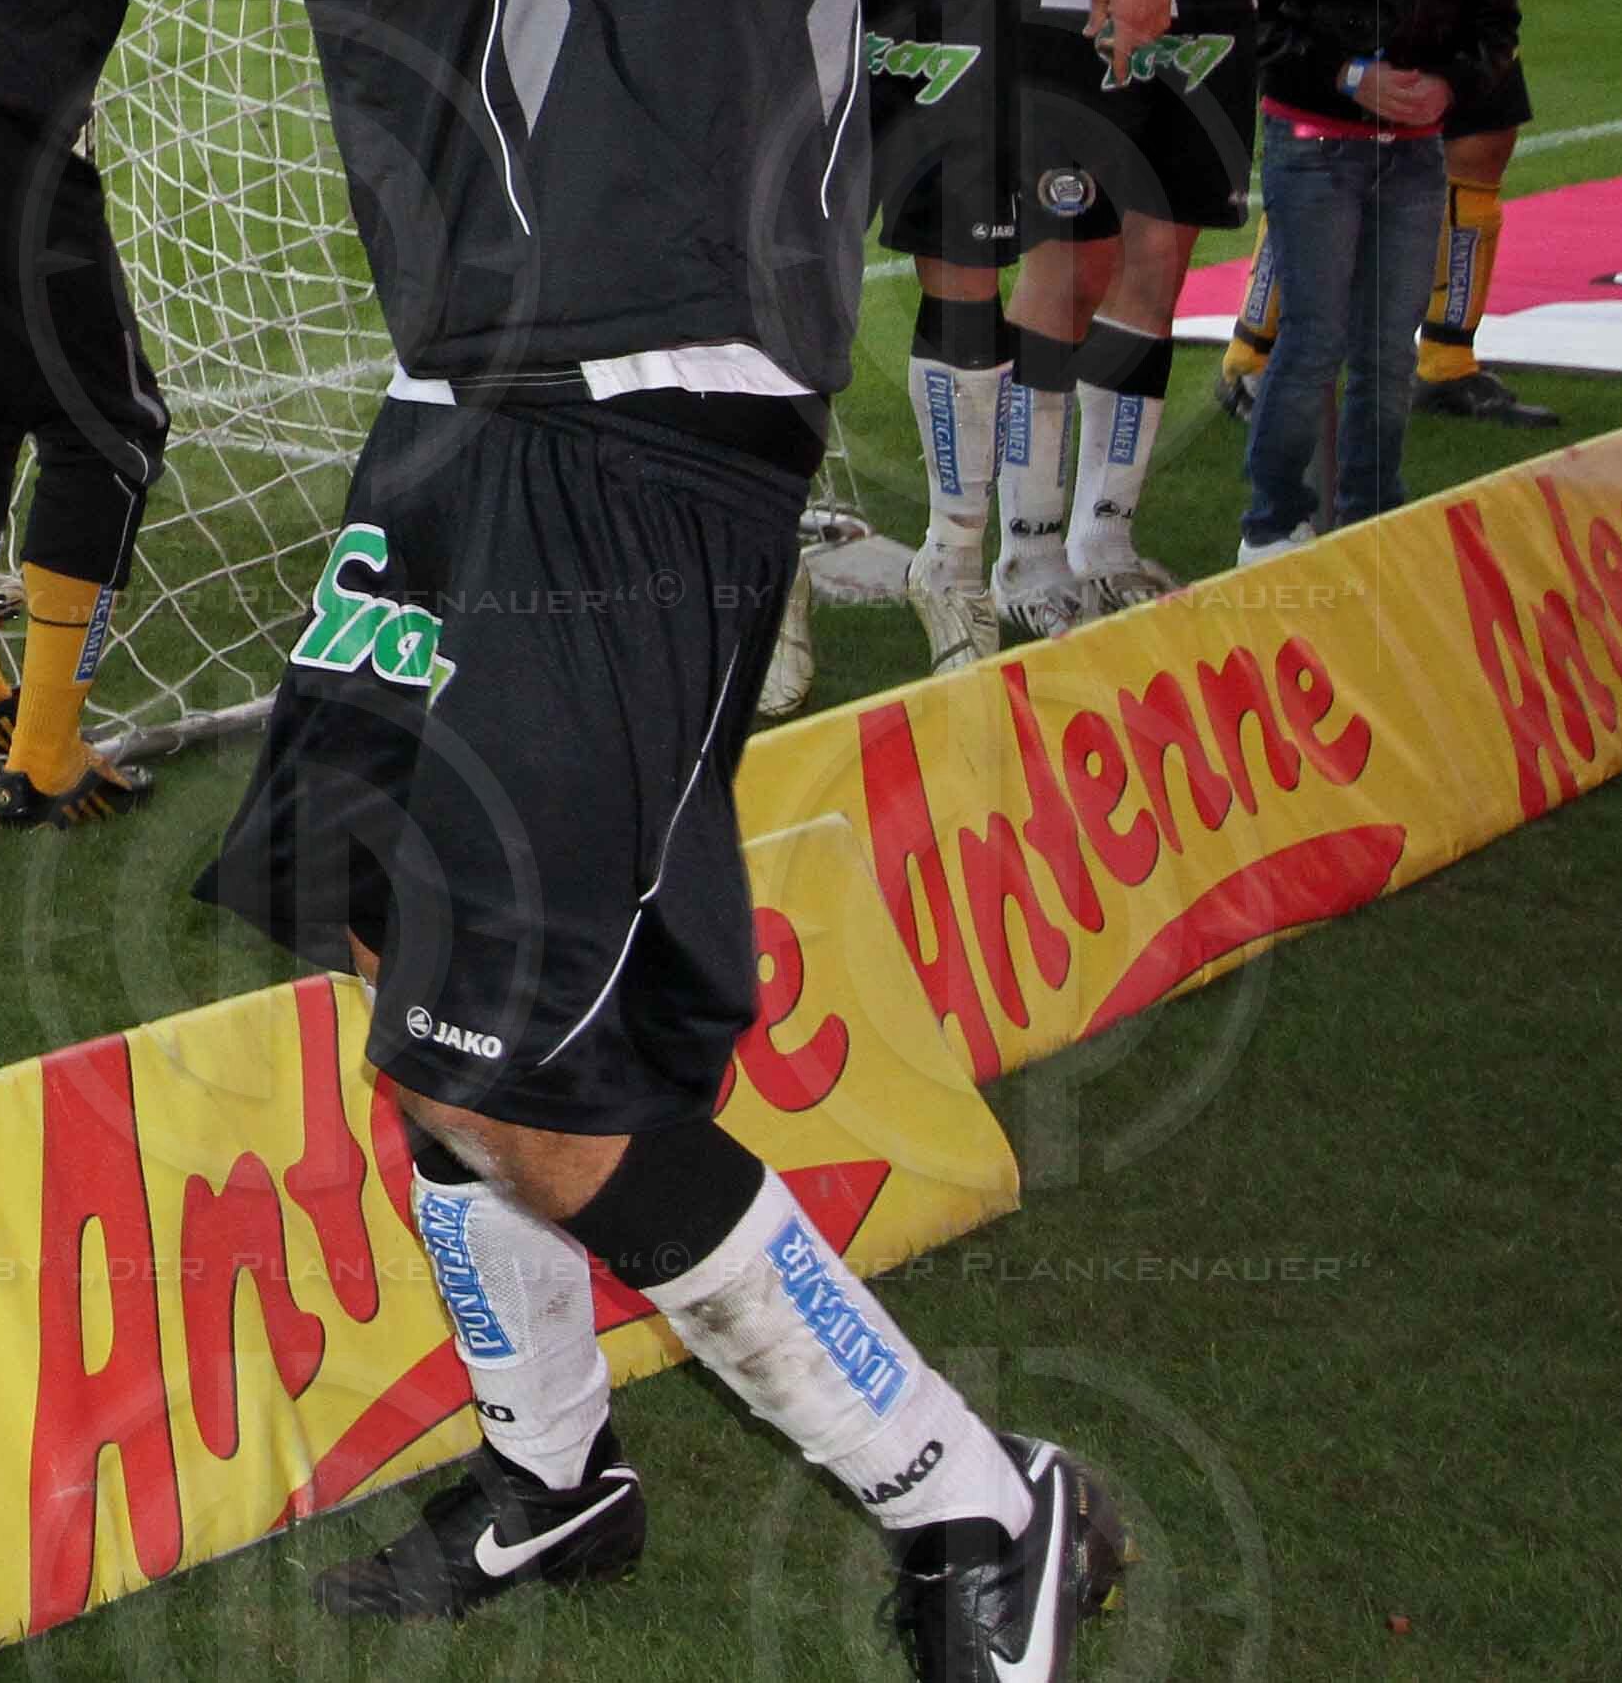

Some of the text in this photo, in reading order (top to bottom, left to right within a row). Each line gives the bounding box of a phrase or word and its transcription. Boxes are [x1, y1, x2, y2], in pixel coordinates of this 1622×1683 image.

[928, 373, 957, 492] PUNTIGAMER
[1113, 396, 1140, 460] IGAMER
[856, 636, 1372, 1082] Antenne
[433, 1021, 503, 1059] JAKO
